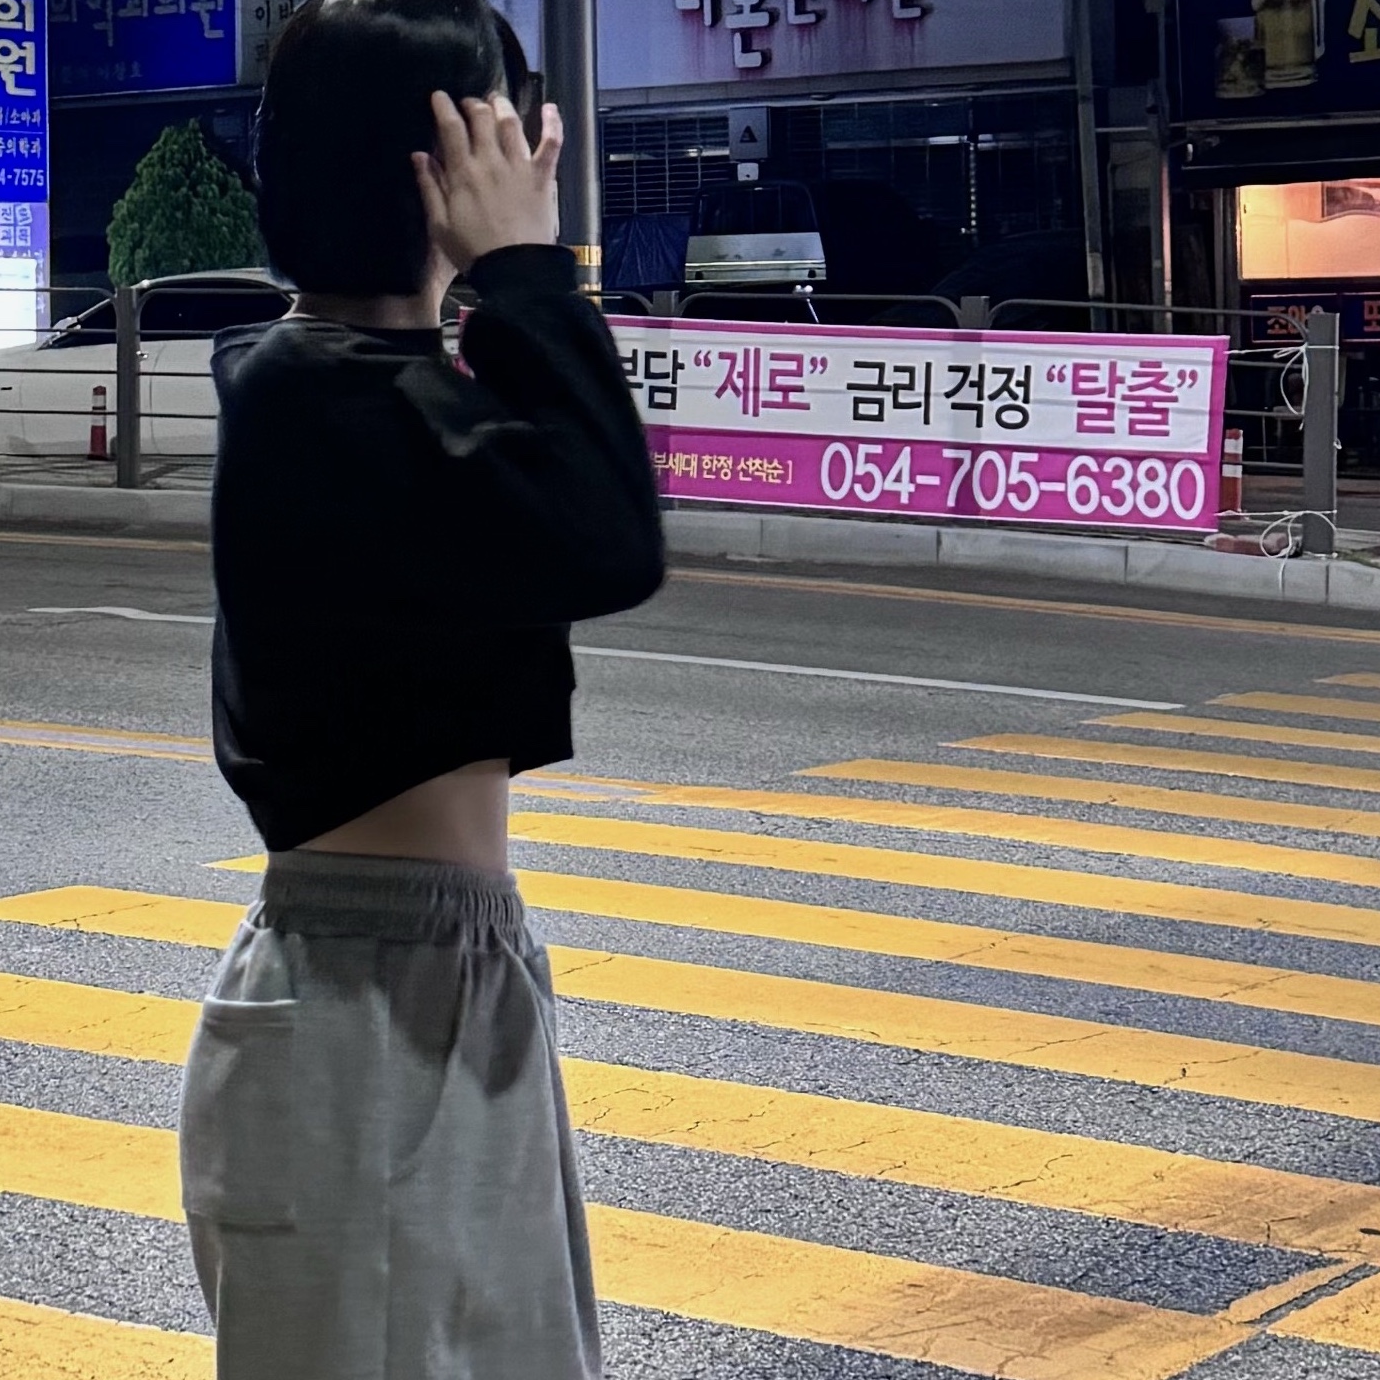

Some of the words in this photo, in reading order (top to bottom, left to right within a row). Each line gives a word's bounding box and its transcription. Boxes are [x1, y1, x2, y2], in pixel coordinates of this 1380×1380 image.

[846, 359, 931, 426] 금리
[944, 362, 1033, 431] 걱정
[701, 454, 734, 482] 한정
[820, 440, 1207, 521] 054-705-6380
